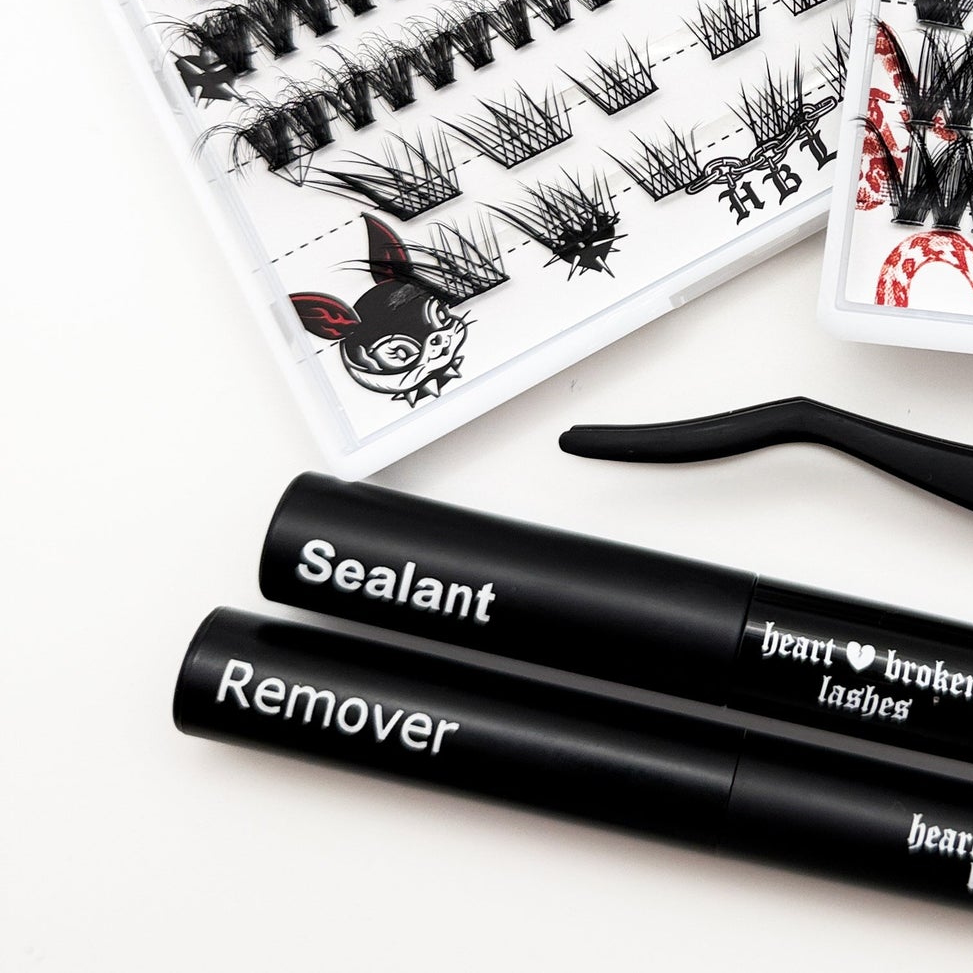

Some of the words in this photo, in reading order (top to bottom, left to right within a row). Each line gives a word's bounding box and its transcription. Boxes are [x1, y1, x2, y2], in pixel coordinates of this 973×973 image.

[297, 539, 495, 623] Sealant
[761, 622, 836, 666] heart
[216, 659, 460, 754] Remover
[818, 675, 913, 720] lashes
